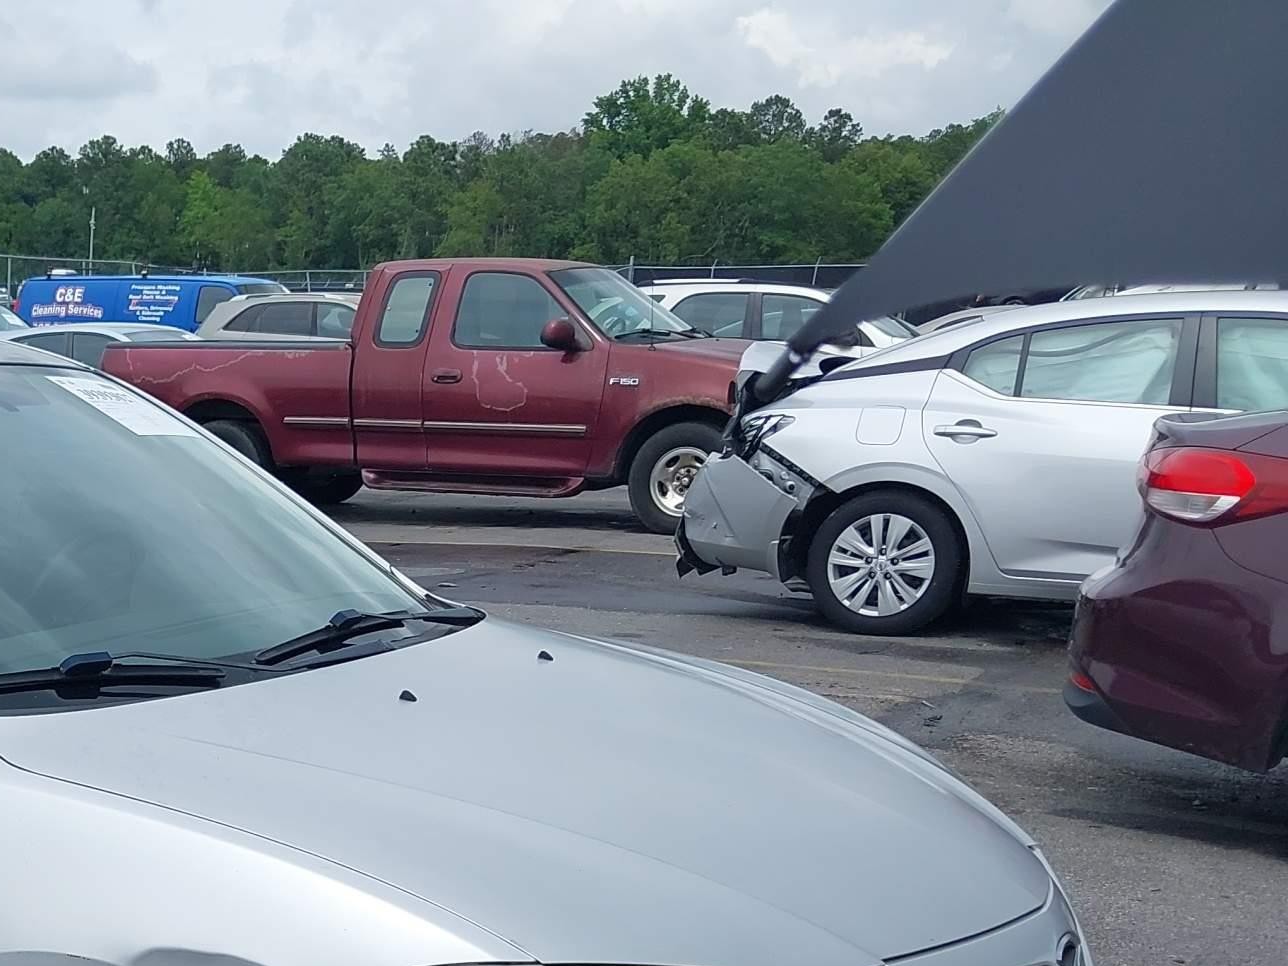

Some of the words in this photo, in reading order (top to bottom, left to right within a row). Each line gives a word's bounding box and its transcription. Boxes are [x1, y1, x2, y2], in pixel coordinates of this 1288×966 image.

[56, 287, 85, 302] C&E
[32, 305, 66, 317] Cleaning
[68, 305, 103, 318] Services
